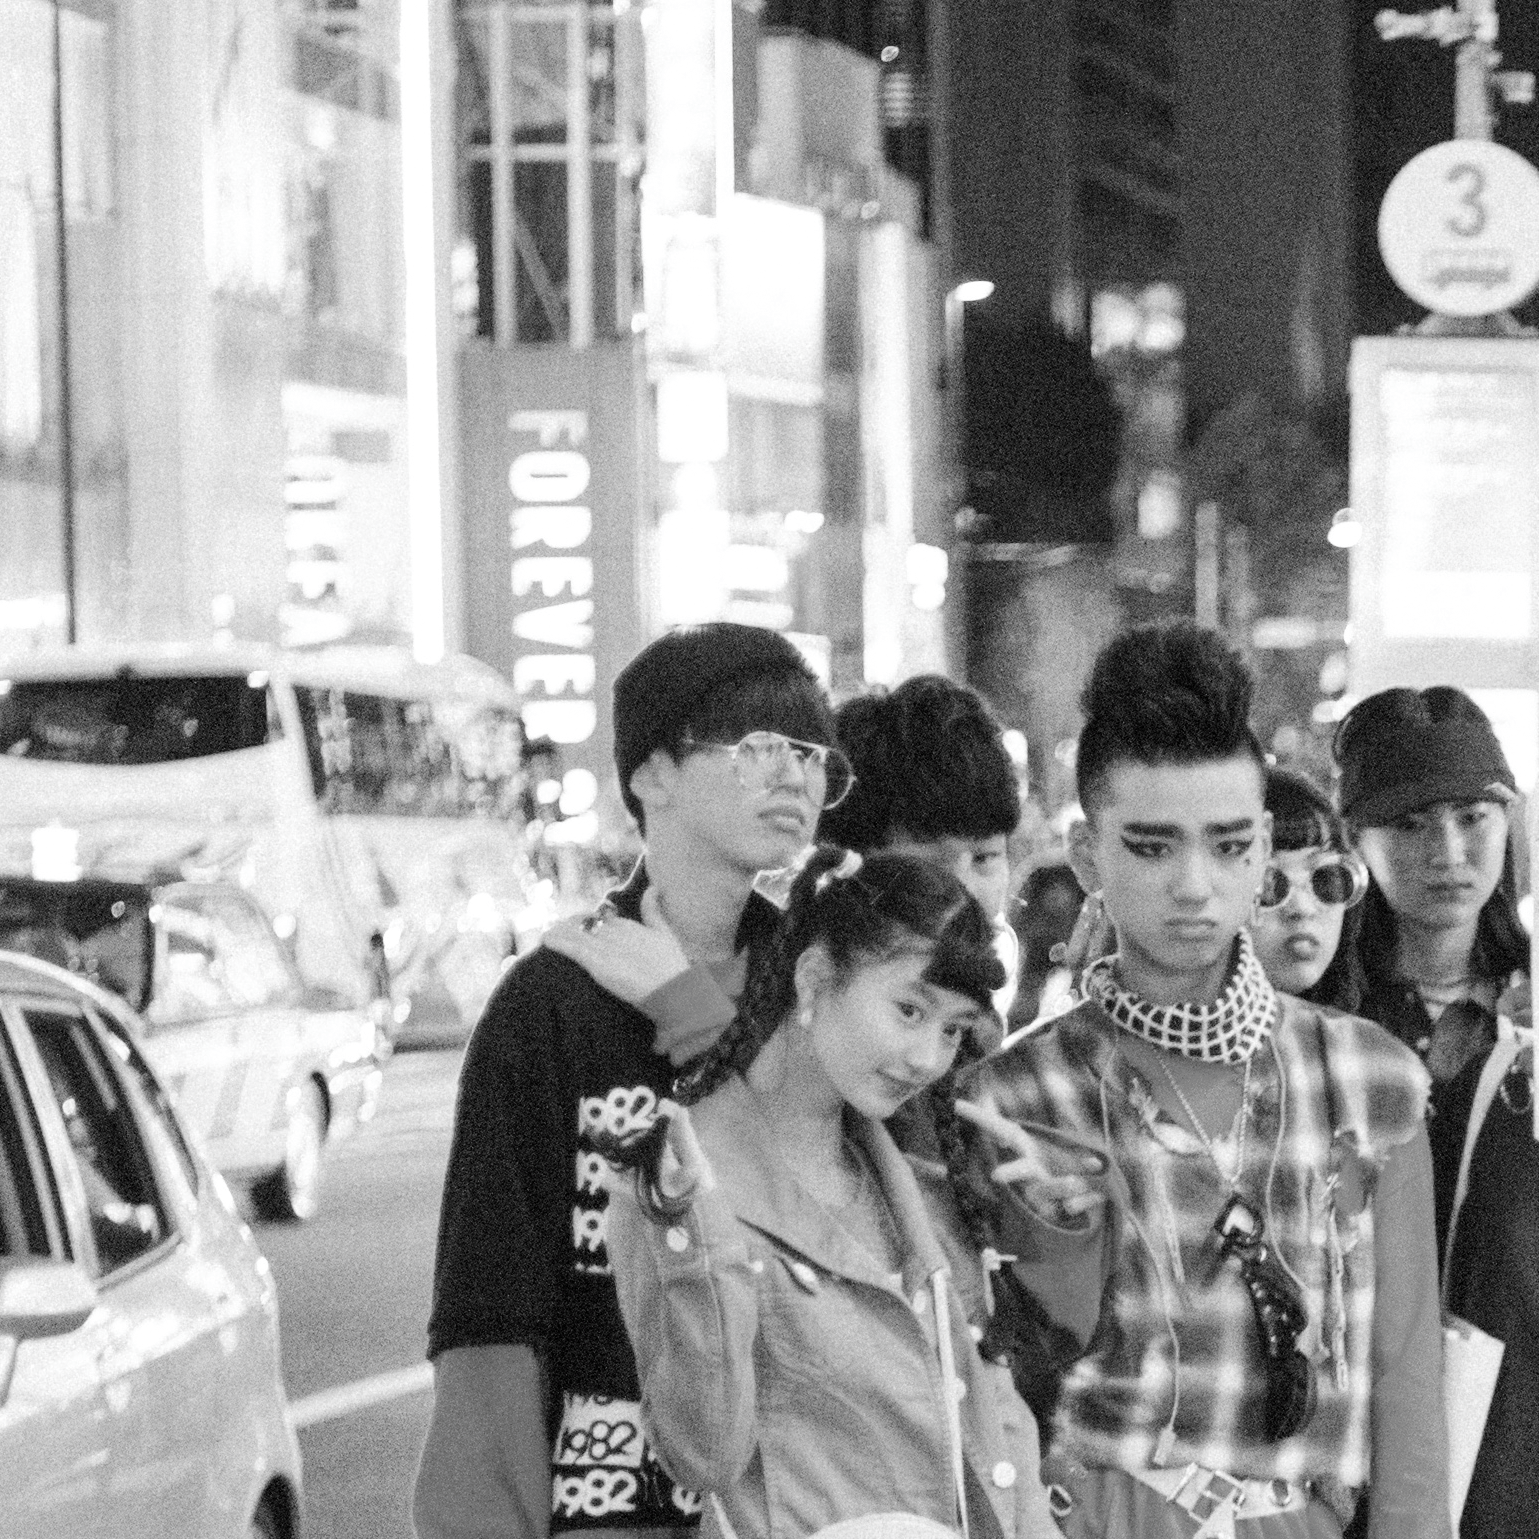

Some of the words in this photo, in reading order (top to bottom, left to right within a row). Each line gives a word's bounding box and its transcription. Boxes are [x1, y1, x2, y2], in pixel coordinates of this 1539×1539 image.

[1446, 163, 1487, 237] 3
[507, 410, 597, 744] FOREVER
[579, 1085, 656, 1135] 1982
[573, 1206, 609, 1252] 19
[559, 1420, 639, 1464] 1982
[553, 1469, 639, 1518] 1982
